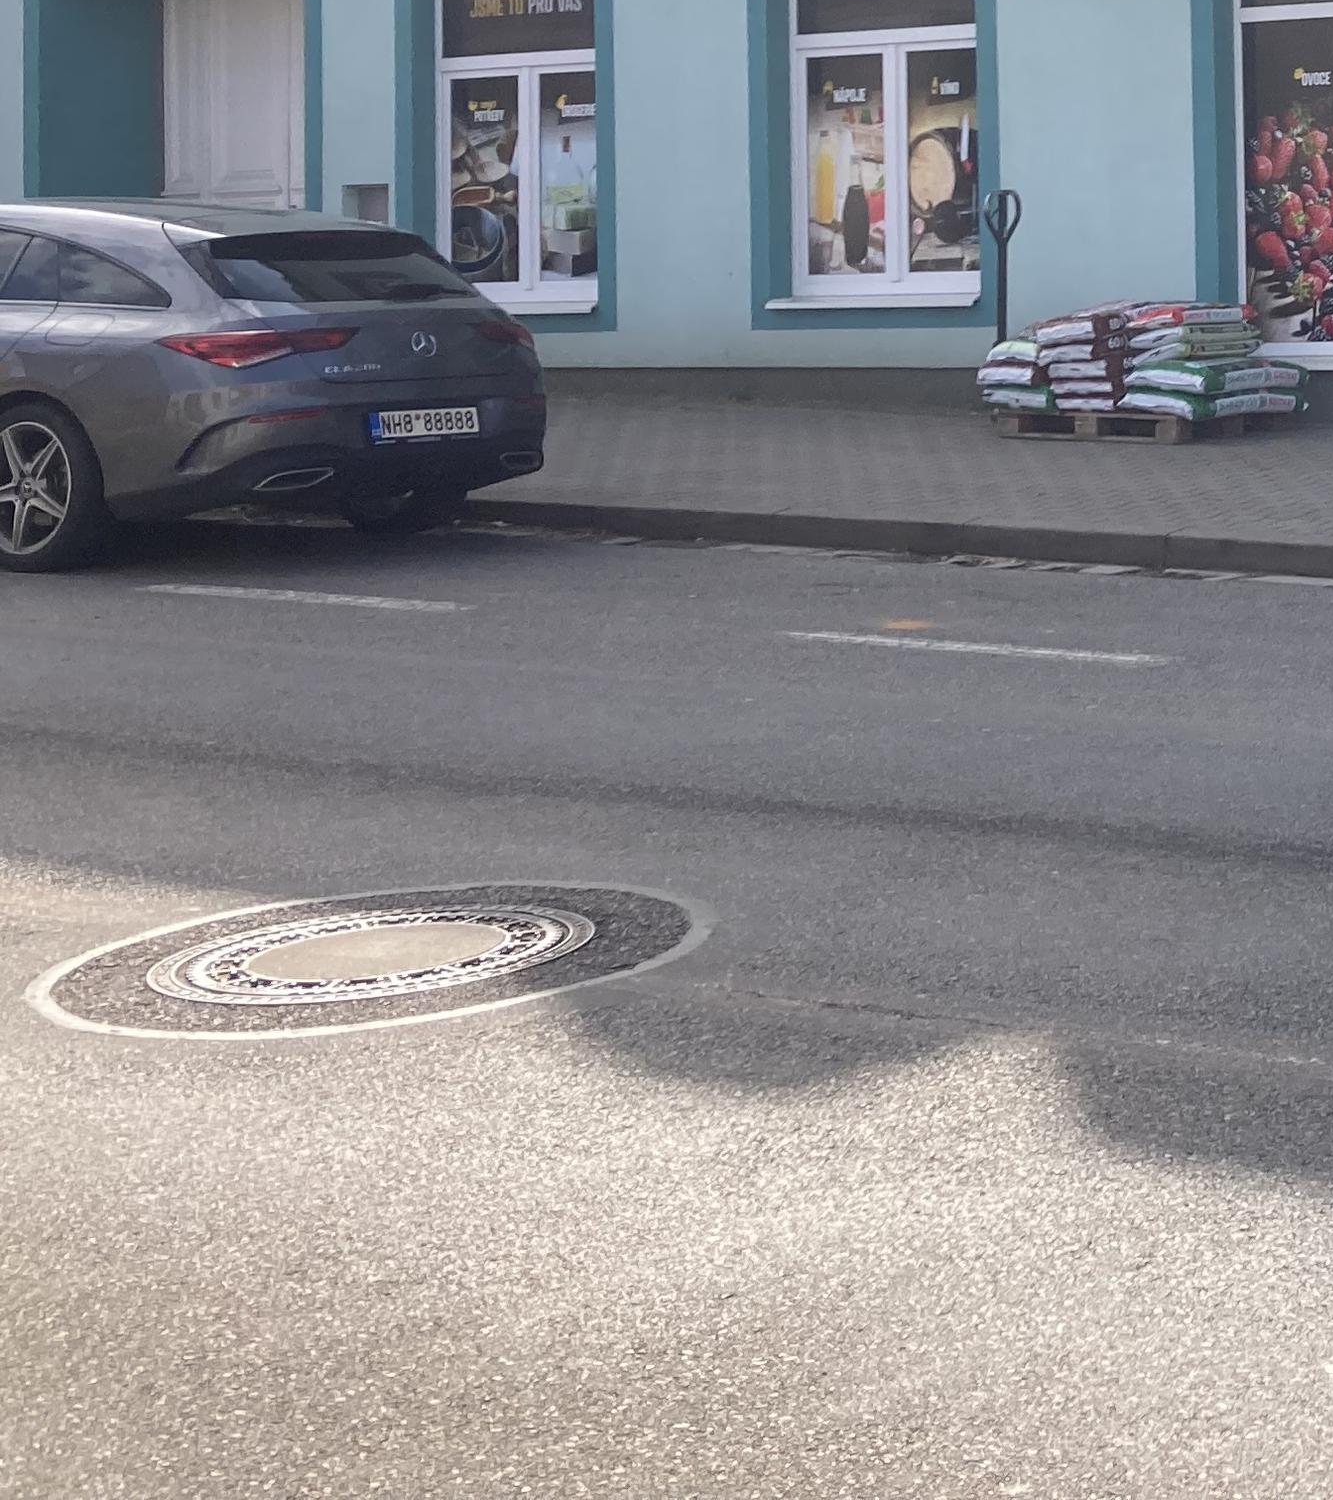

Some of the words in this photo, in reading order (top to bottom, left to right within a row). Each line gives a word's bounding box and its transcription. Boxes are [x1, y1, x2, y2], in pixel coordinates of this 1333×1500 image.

[1301, 71, 1331, 86] OVOCE
[381, 413, 414, 436] NH8
[424, 410, 475, 432] 88888
